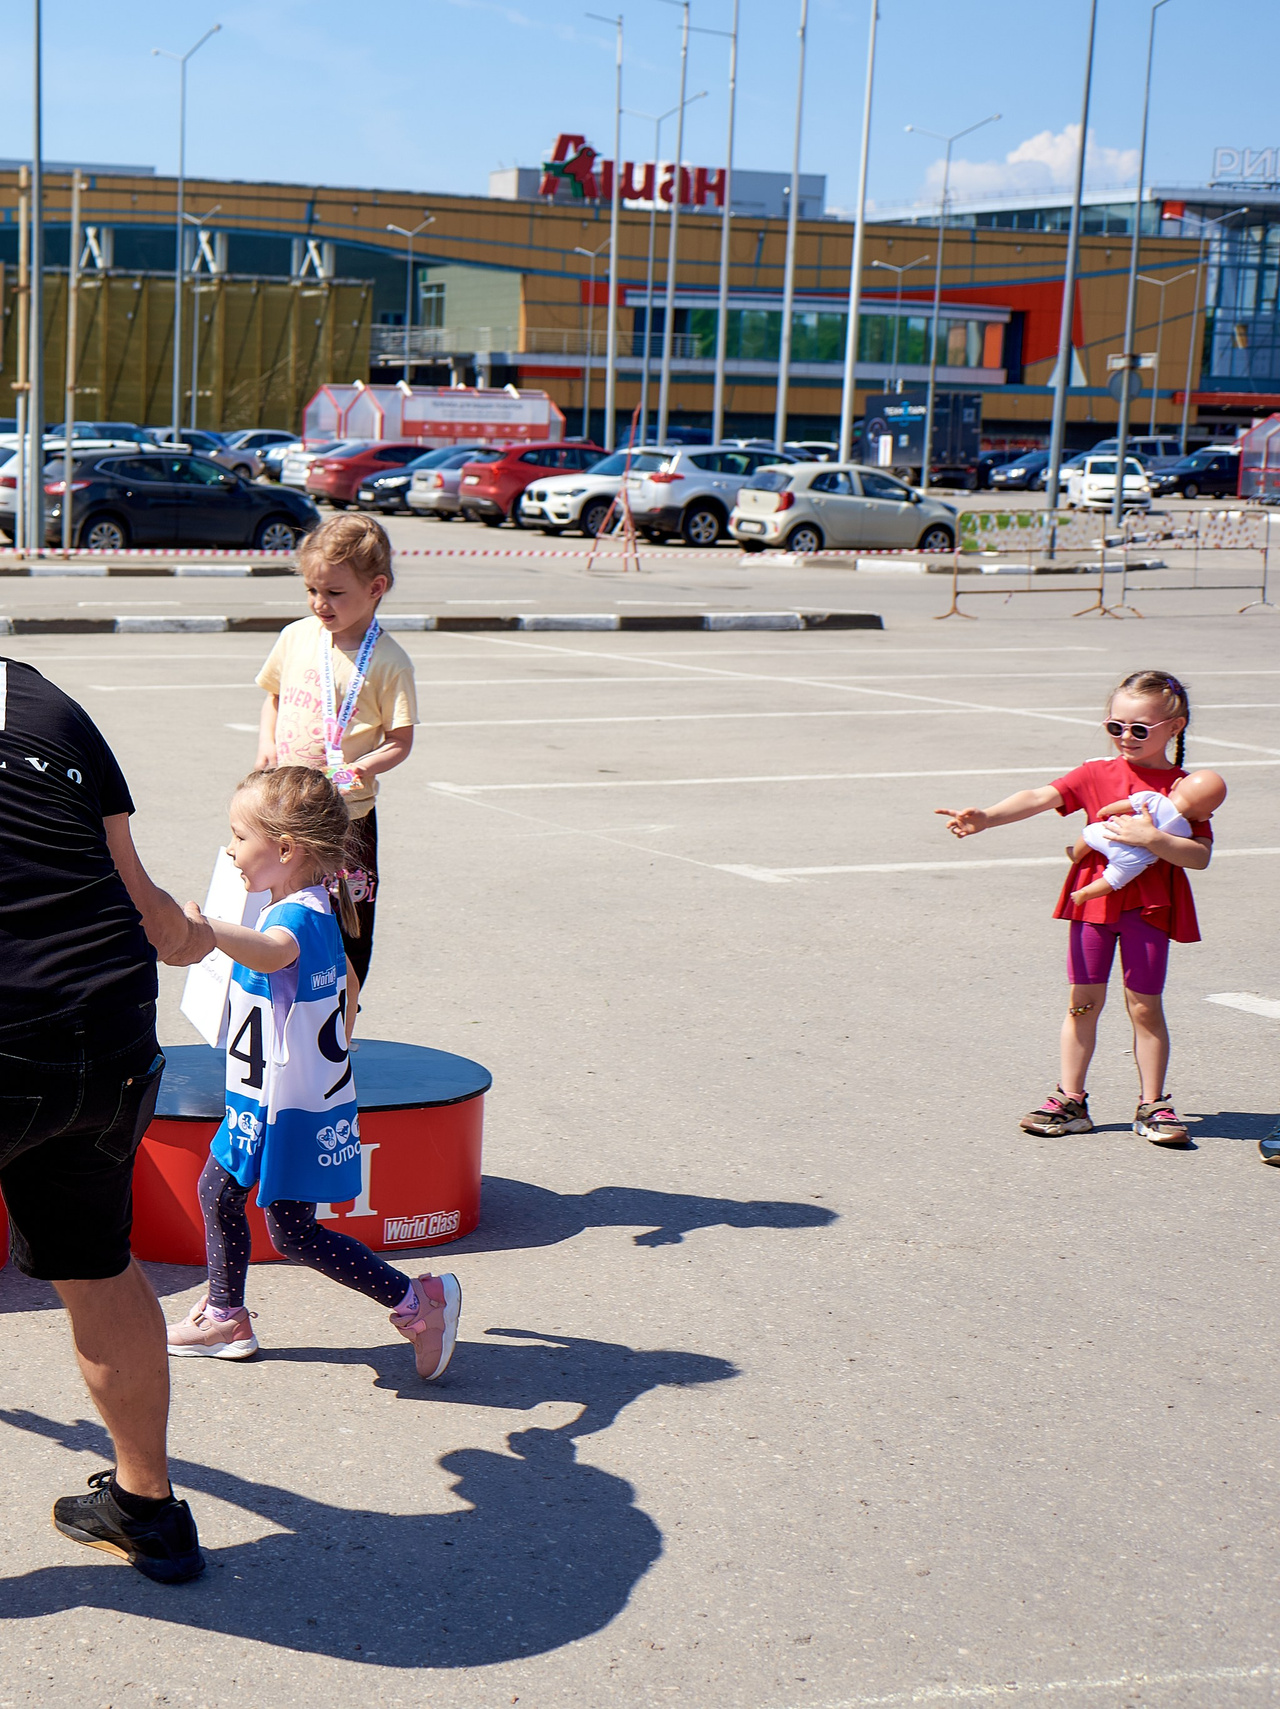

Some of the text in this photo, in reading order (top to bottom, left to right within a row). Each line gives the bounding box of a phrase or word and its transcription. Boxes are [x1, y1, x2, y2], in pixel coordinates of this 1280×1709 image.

[1211, 146, 1280, 179] РИ
[386, 1213, 458, 1241] World Class
